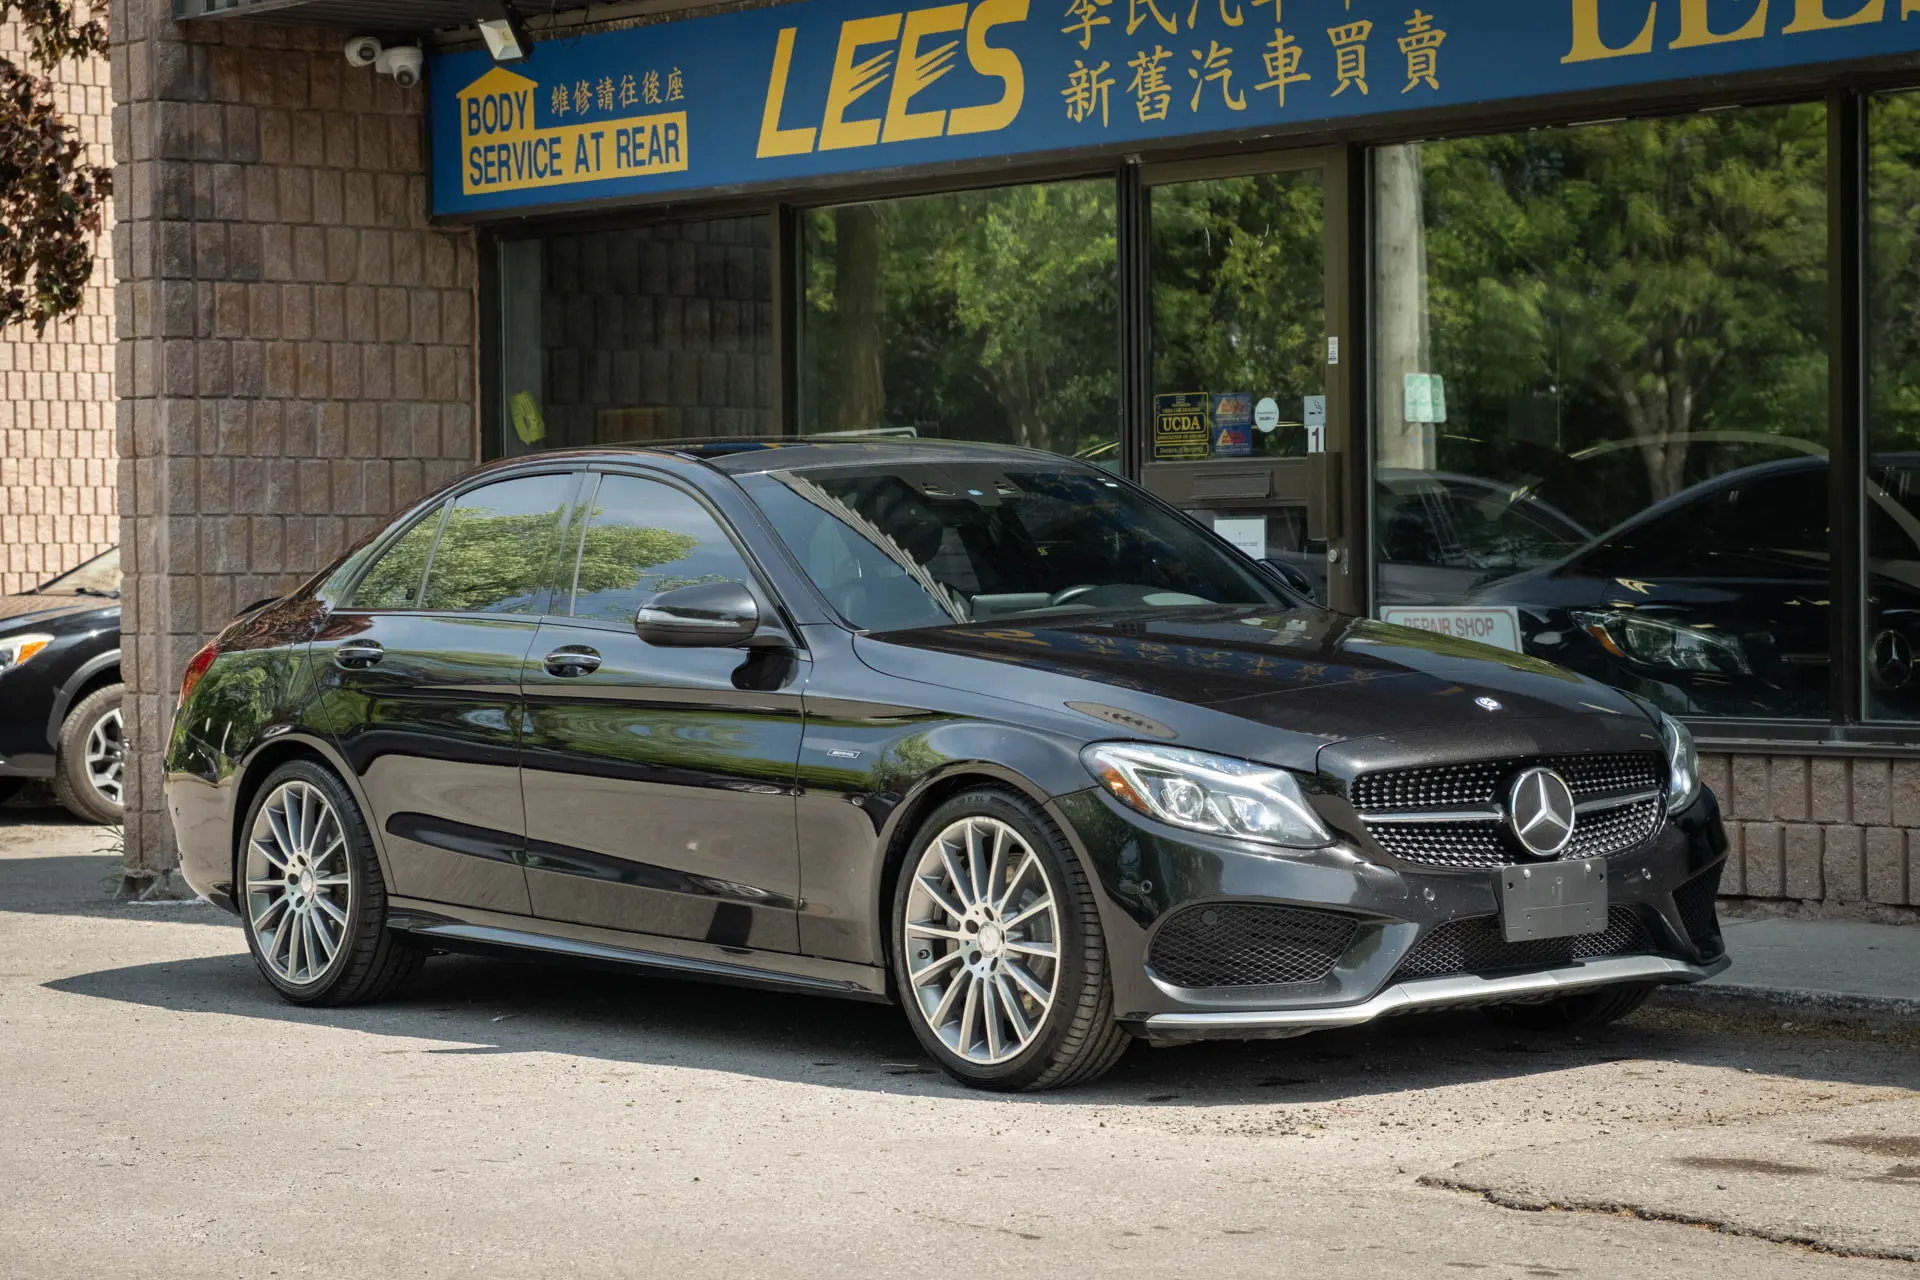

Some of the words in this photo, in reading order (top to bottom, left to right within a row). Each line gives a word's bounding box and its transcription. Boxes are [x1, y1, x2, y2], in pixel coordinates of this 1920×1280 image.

[551, 66, 684, 117] 維修請往後座
[756, 0, 1030, 158] LEES
[1061, 9, 1447, 127] 新舊汽車買賣
[468, 90, 527, 136] BODY
[469, 136, 563, 186] SERVICE
[574, 131, 604, 173] AT
[616, 122, 680, 169] REAR
[1163, 416, 1201, 431] UCDA
[1311, 427, 1320, 451] 1
[1455, 617, 1494, 637] SHOP
